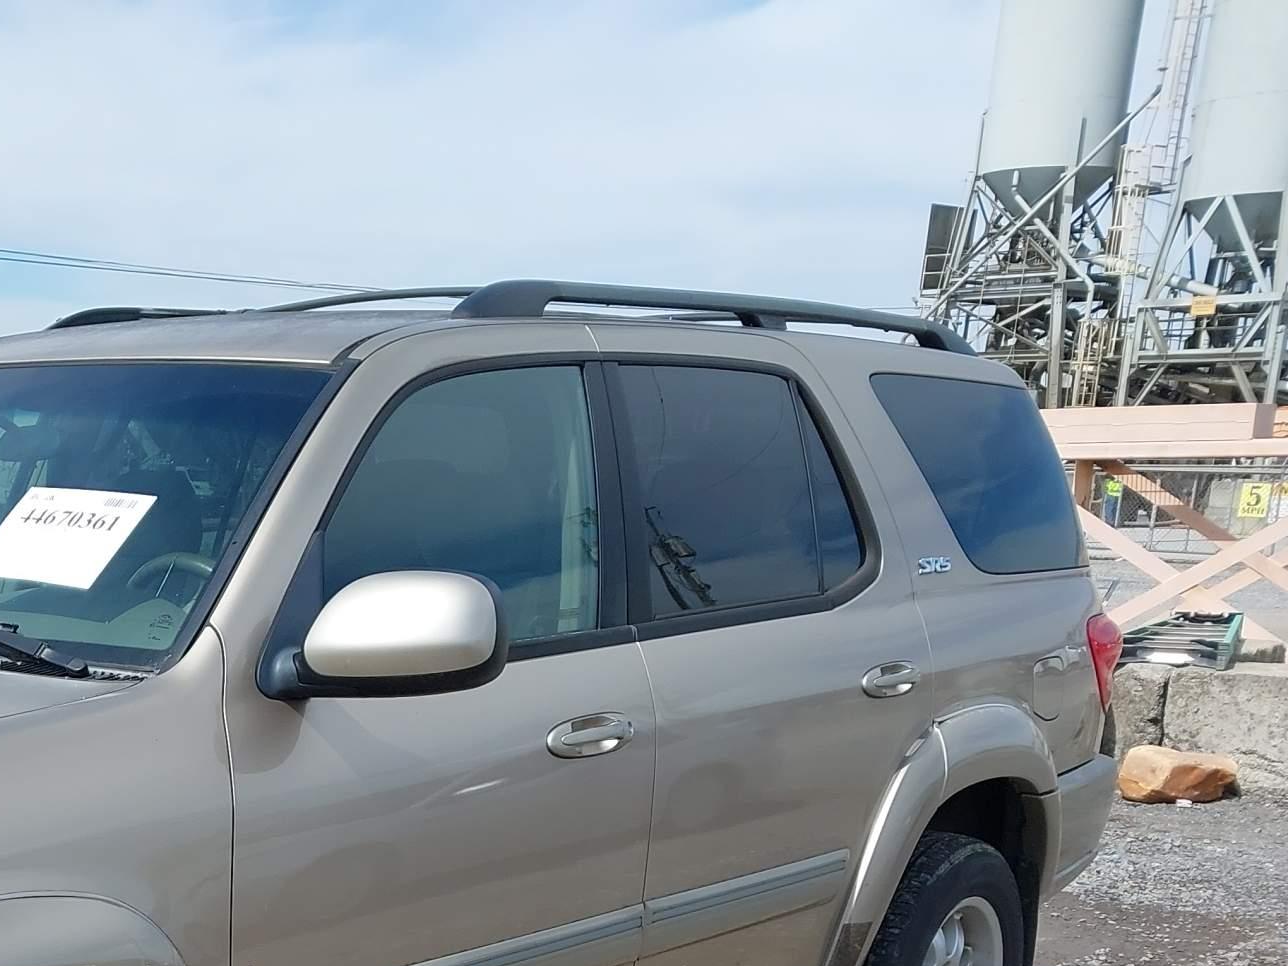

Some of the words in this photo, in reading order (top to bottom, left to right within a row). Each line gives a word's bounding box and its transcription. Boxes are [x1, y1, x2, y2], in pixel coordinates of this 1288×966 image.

[1246, 485, 1261, 507] 5
[20, 508, 120, 532] 44670361
[918, 556, 952, 575] SR5
